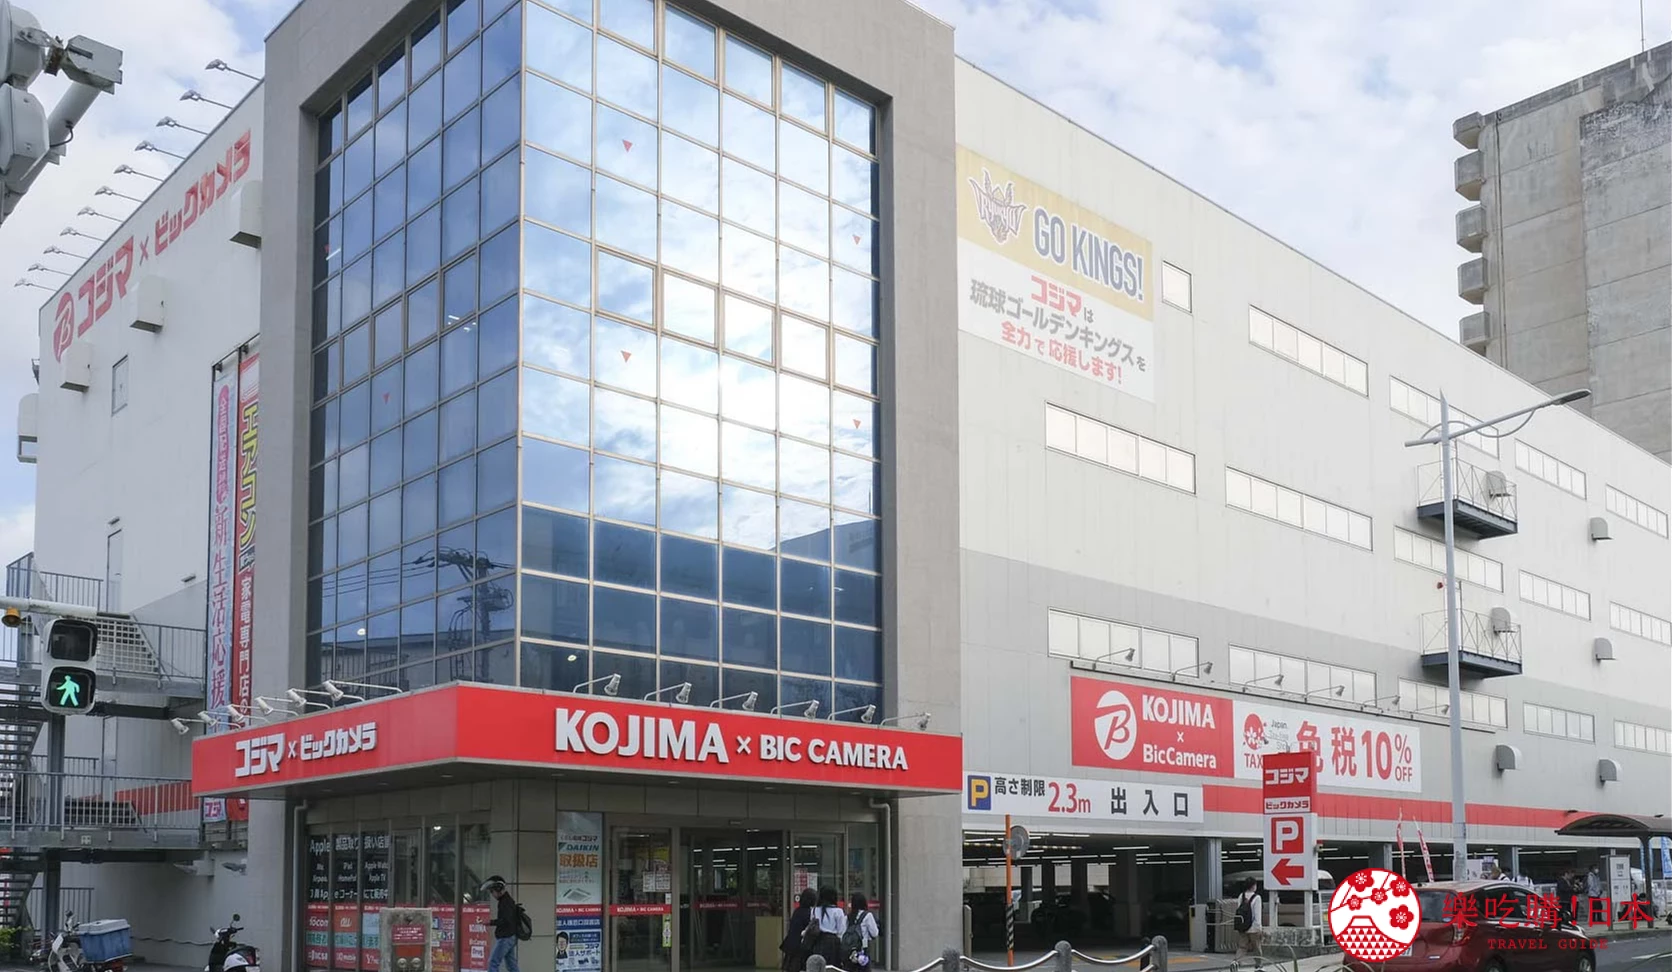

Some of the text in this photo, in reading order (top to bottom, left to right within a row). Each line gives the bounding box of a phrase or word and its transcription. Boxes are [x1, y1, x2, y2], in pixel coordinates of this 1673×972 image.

[78, 236, 134, 338] コジマ
[155, 129, 251, 256] ビックカメラ
[1034, 208, 1143, 301] GO KINGS!
[240, 401, 258, 551] エアコン
[211, 505, 228, 735] 新生活応援
[239, 578, 252, 727] 家電専門店の
[1142, 694, 1216, 730] KOJIMA
[235, 733, 285, 778] コジマ
[300, 721, 377, 762] ビックカメラ
[555, 707, 729, 764] KOJIMA
[760, 734, 802, 762] BIC
[807, 739, 909, 771] CAMERA
[1142, 743, 1217, 769] BicCamera
[1265, 767, 1309, 785] コジマ
[1395, 766, 1413, 782] OFF
[994, 777, 1046, 797] 高さ制限
[1048, 782, 1091, 814] 2.3m
[1266, 800, 1309, 810] ビックカメラ
[566, 843, 599, 851] DAIKIN
[1276, 820, 1299, 851] P
[559, 853, 598, 868] 取扱店
